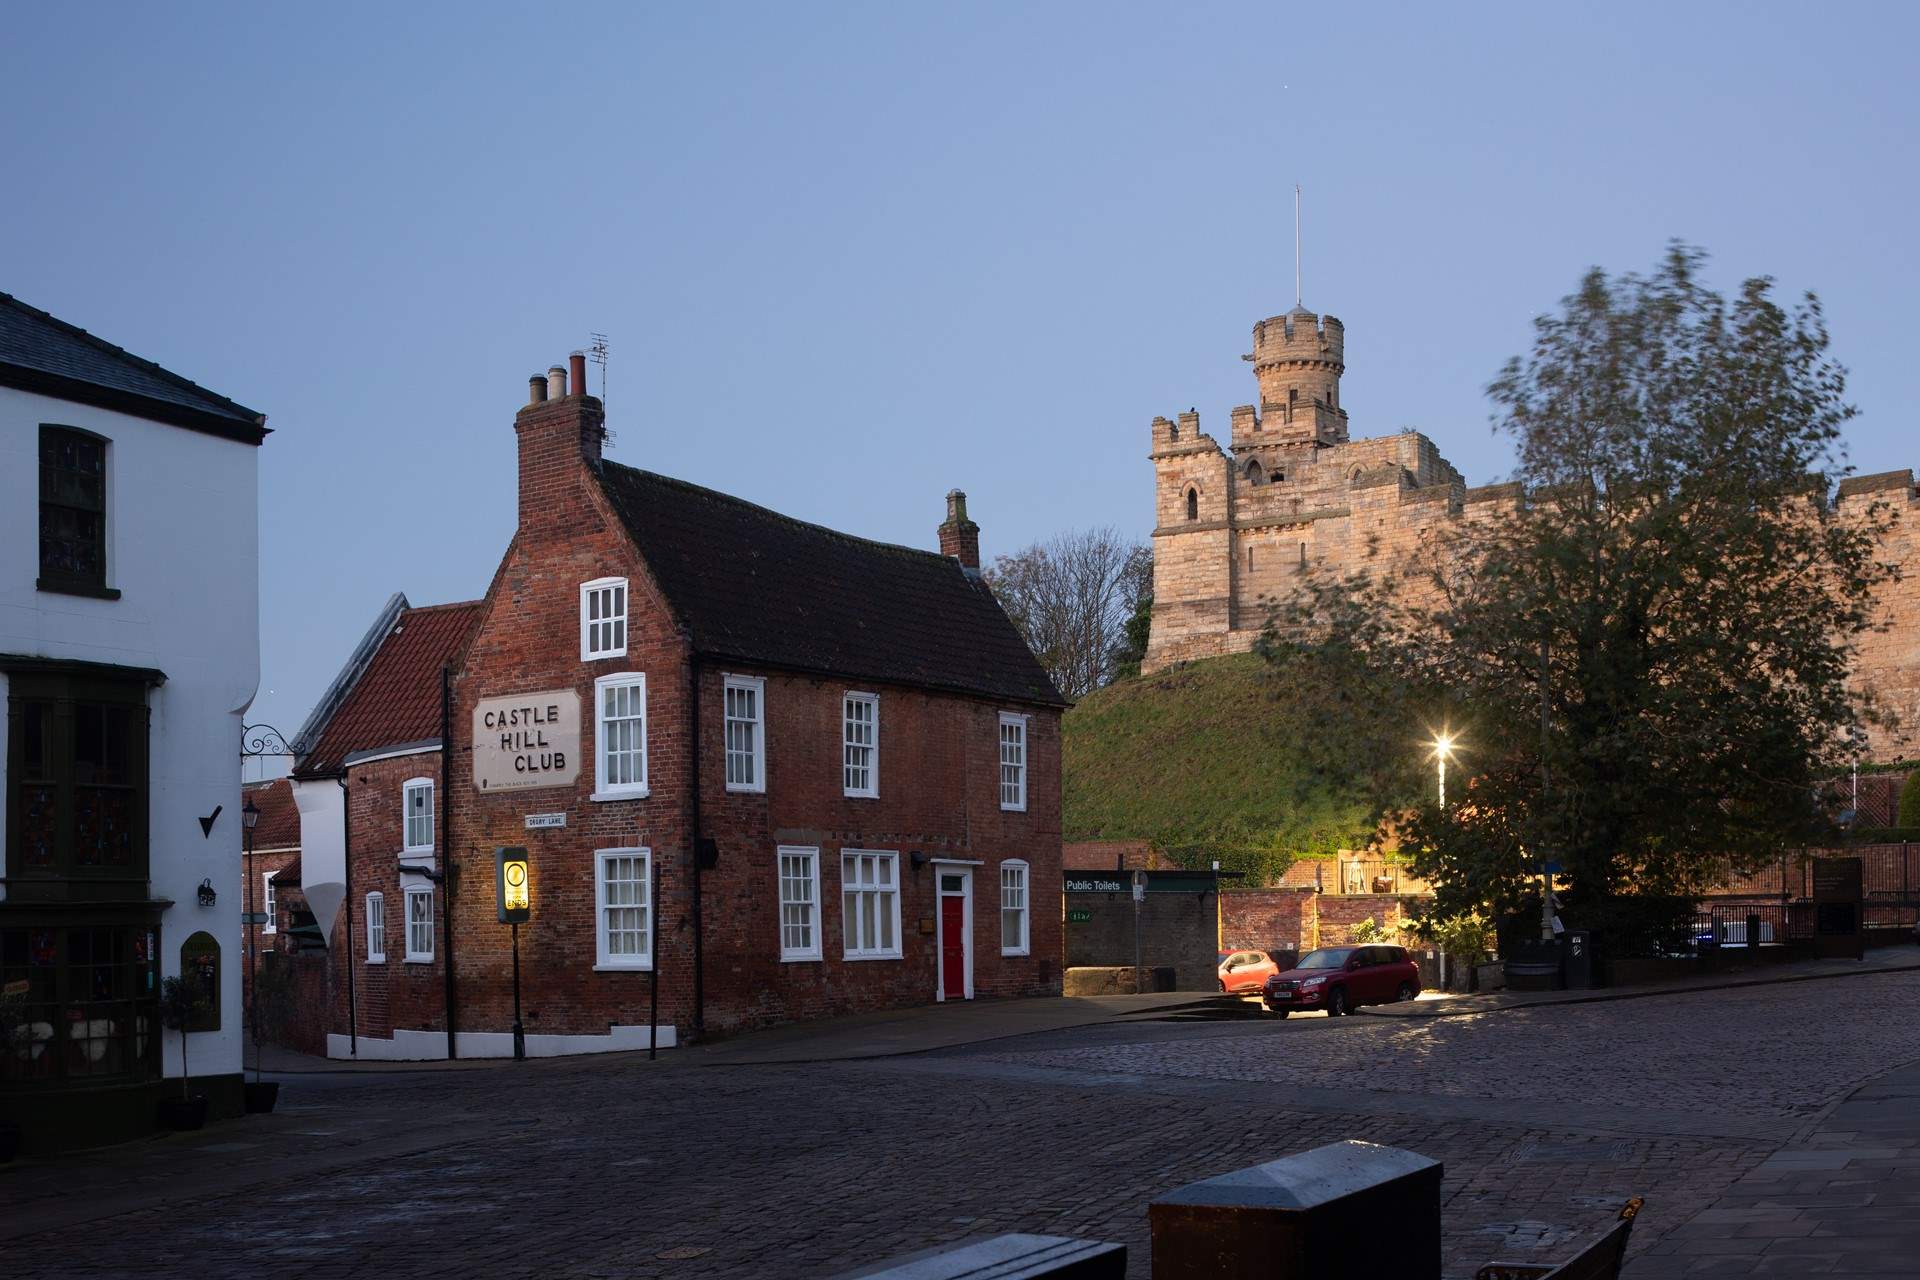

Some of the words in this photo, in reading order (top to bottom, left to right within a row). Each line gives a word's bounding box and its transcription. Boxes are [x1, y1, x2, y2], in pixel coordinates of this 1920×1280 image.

[484, 705, 559, 728] CASTLE
[500, 730, 549, 750] HILL
[514, 752, 567, 772] CLUB
[1066, 880, 1092, 890] Public
[1093, 881, 1120, 890] Toilets
[507, 899, 527, 907] ENDS
